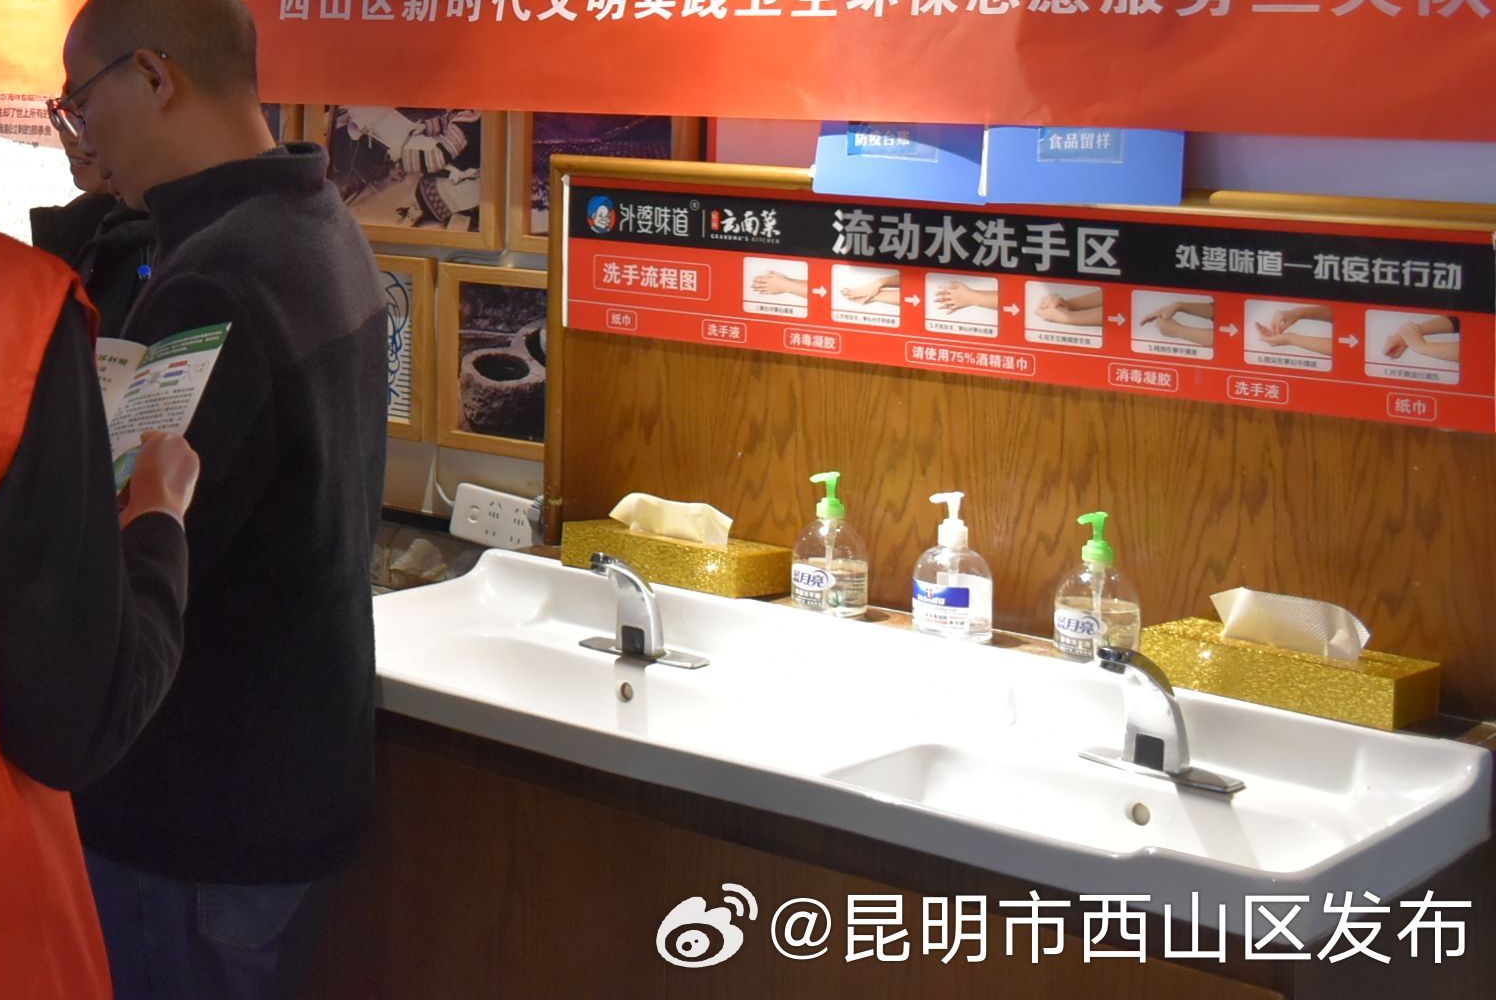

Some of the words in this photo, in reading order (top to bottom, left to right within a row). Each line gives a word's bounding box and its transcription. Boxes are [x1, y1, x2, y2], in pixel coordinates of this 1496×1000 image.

[1048, 131, 1113, 150] 食品留样
[619, 203, 689, 238] 外婆味道
[720, 208, 782, 238] 云南菜
[831, 208, 1121, 276] 流动水洗手区
[602, 261, 698, 293] 洗手流程图
[611, 313, 633, 328] 纸巾
[706, 323, 741, 340] 洗手液
[789, 332, 836, 351] 消毒凝胶
[912, 345, 1029, 372] 请使用75%酒精湿巾
[1115, 367, 1173, 388] 消毒凝胶
[1234, 380, 1280, 400] 洗手液
[1394, 397, 1428, 416] 纸巾
